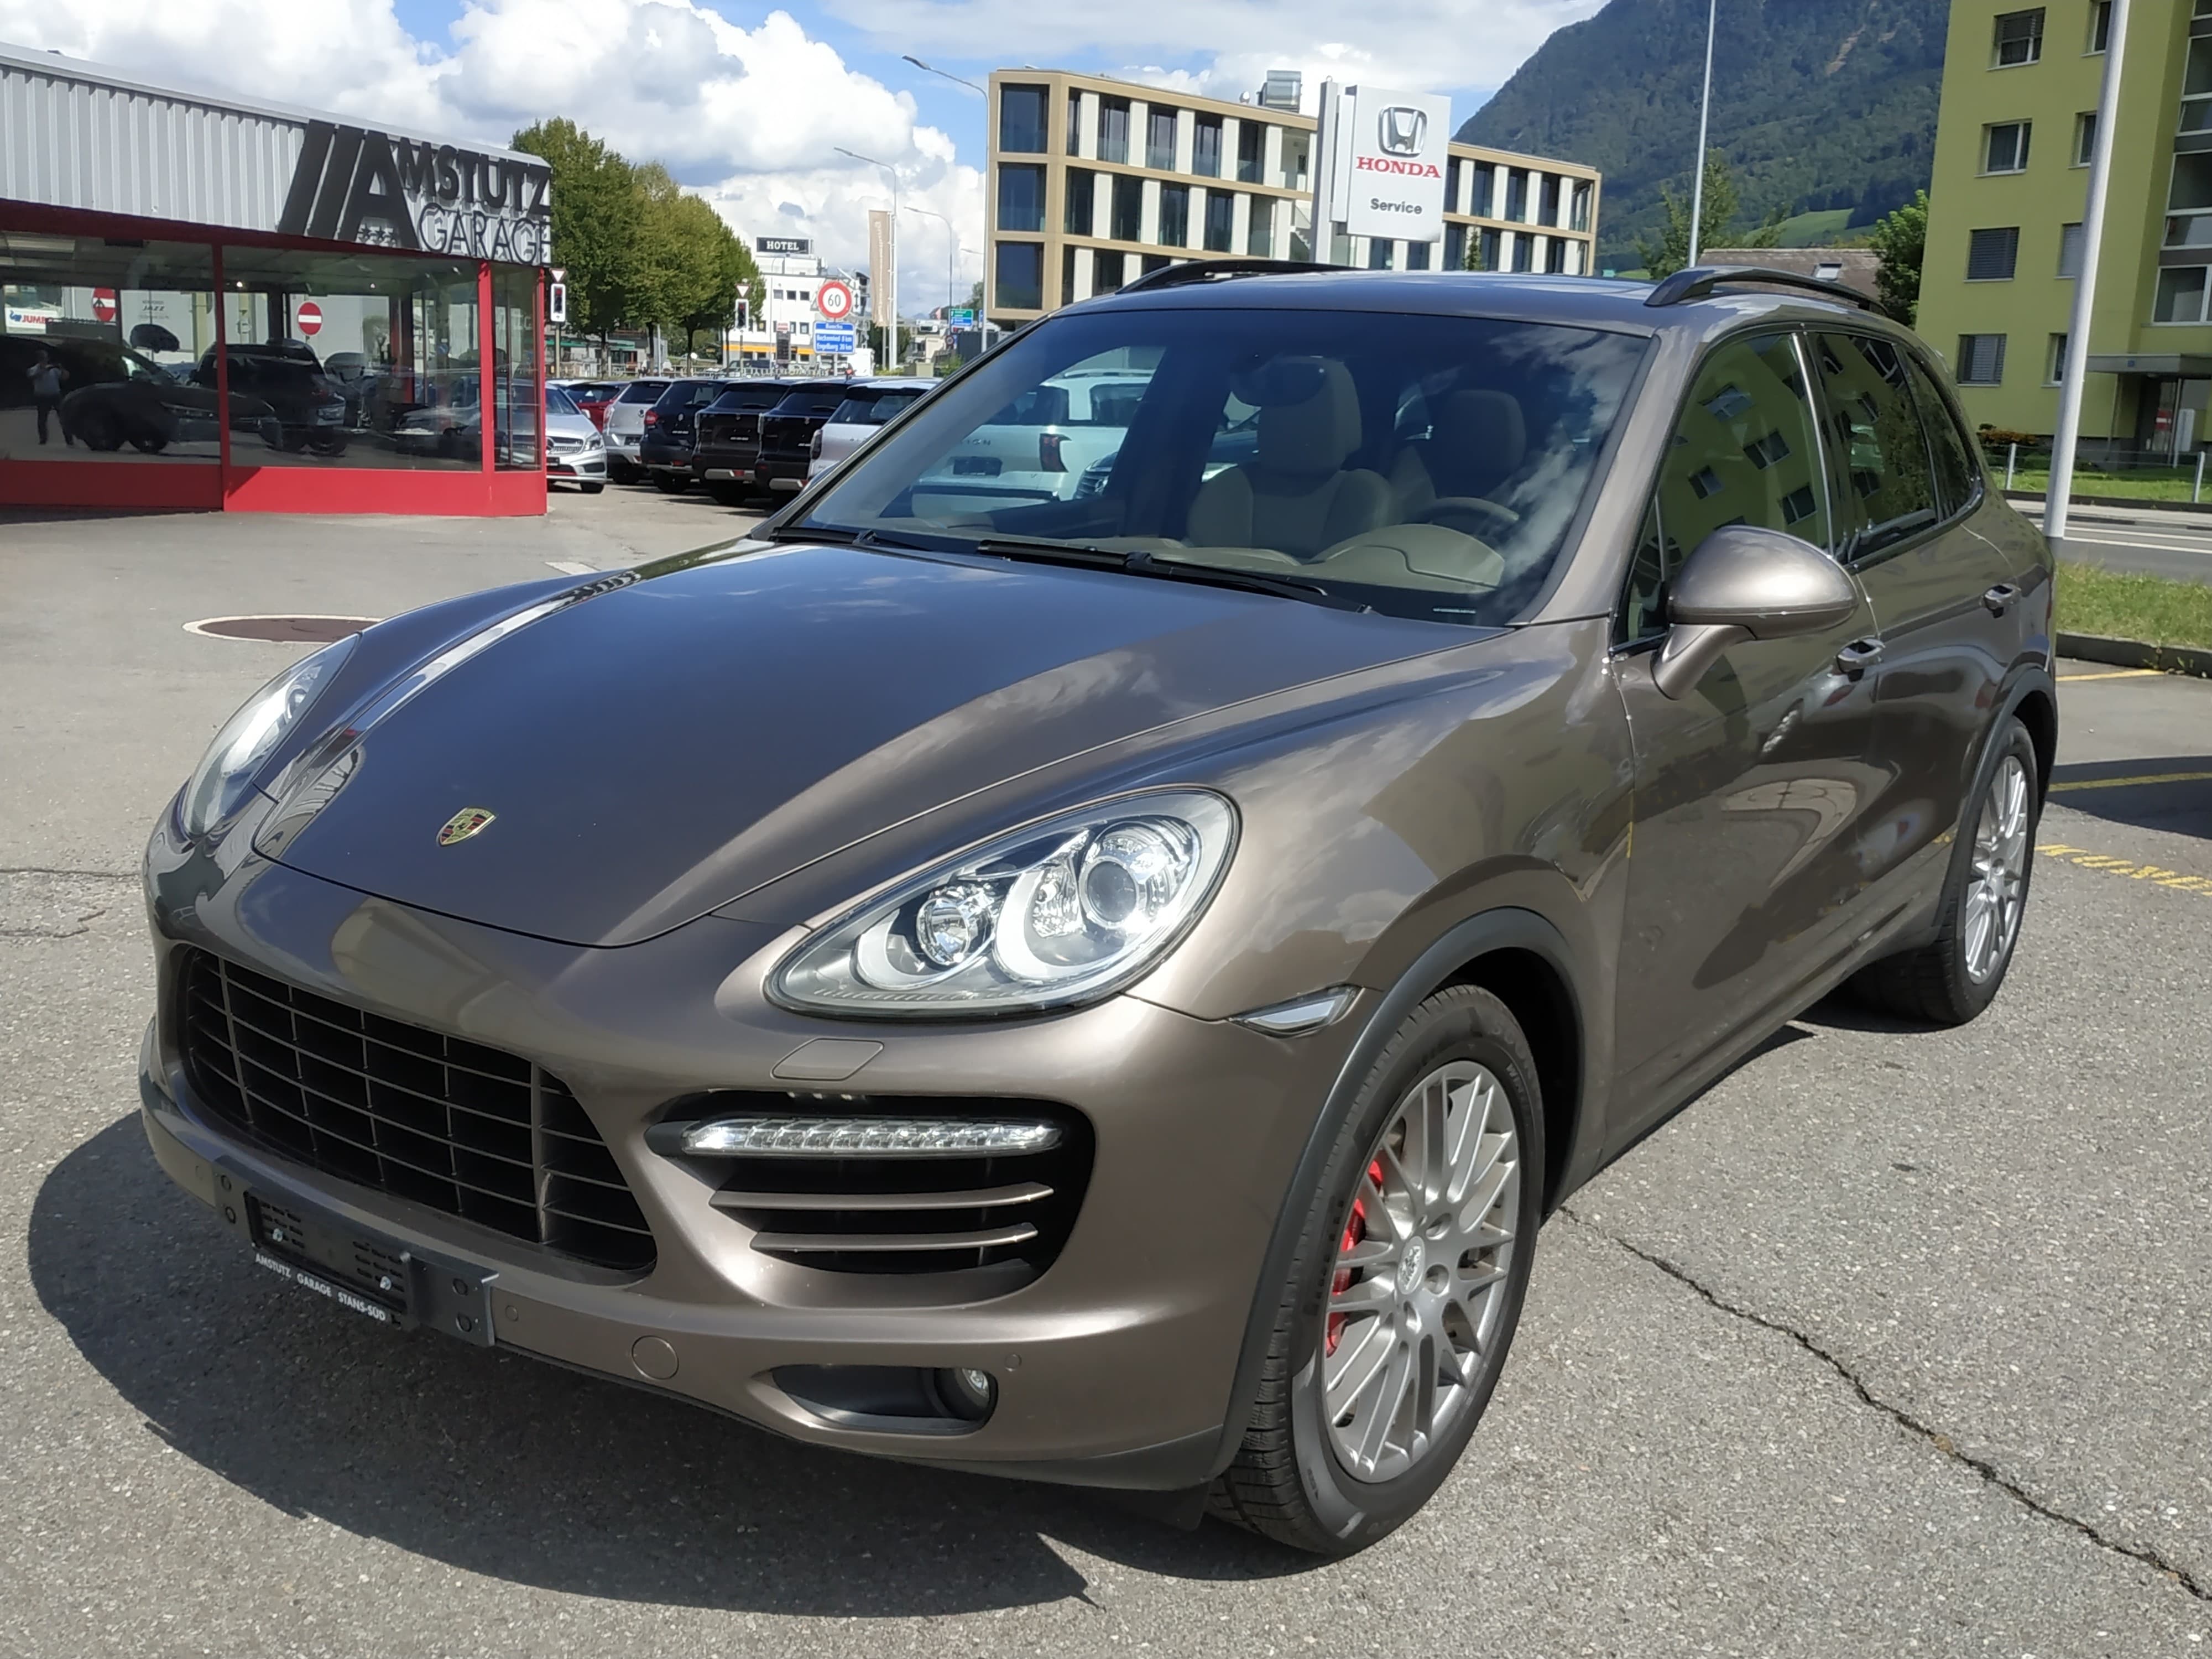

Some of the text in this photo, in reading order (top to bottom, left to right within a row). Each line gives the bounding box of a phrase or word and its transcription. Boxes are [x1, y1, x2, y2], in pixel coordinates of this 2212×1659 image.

[1356, 156, 1441, 179] HONDA
[1370, 198, 1422, 215] Service
[419, 202, 552, 267] GARAGE
[766, 241, 799, 251] HOTEL
[828, 294, 841, 307] 60
[255, 1253, 291, 1277] AMSTUTZ
[296, 1273, 332, 1297] GARAGE
